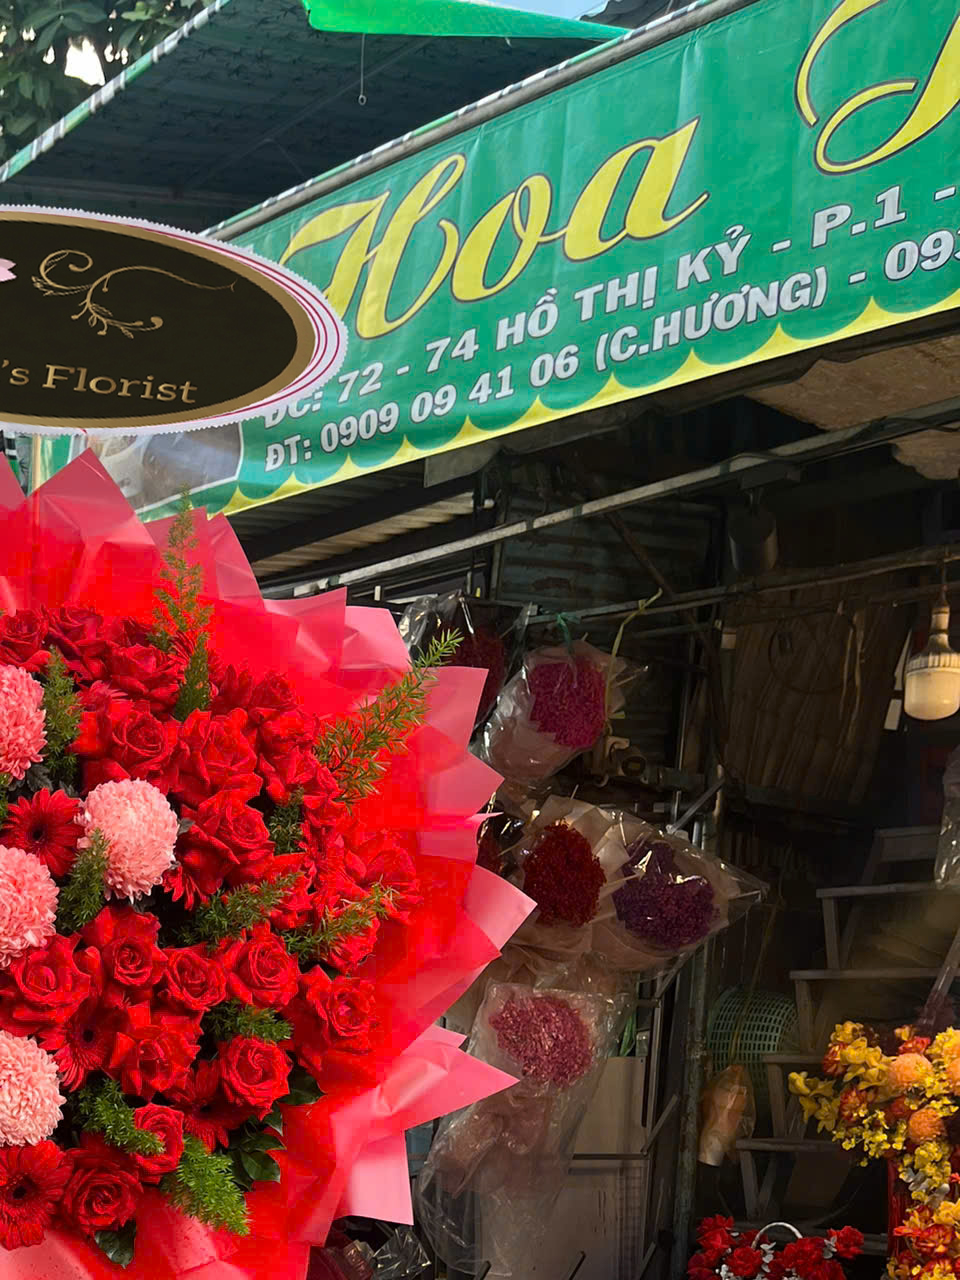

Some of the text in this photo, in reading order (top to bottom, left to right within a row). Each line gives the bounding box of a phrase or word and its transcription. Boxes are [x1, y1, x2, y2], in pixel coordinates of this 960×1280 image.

[280, 117, 709, 340] Hoa
[337, 361, 385, 405] 72
[396, 364, 411, 378] -
[425, 328, 480, 374] 74
[496, 287, 559, 351] HỒ
[574, 266, 658, 323] THỊ
[676, 224, 752, 290] KỶ
[771, 240, 792, 253] -
[811, 184, 907, 249] P.1
[42, 363, 199, 404] Florist
[264, 435, 311, 473] ĐT:
[320, 402, 400, 453] 0909
[410, 384, 457, 424] 09
[468, 365, 515, 405] 41
[529, 343, 580, 388] 06
[595, 266, 828, 371] (C.HƯƠNG)
[883, 227, 960, 282] 09
